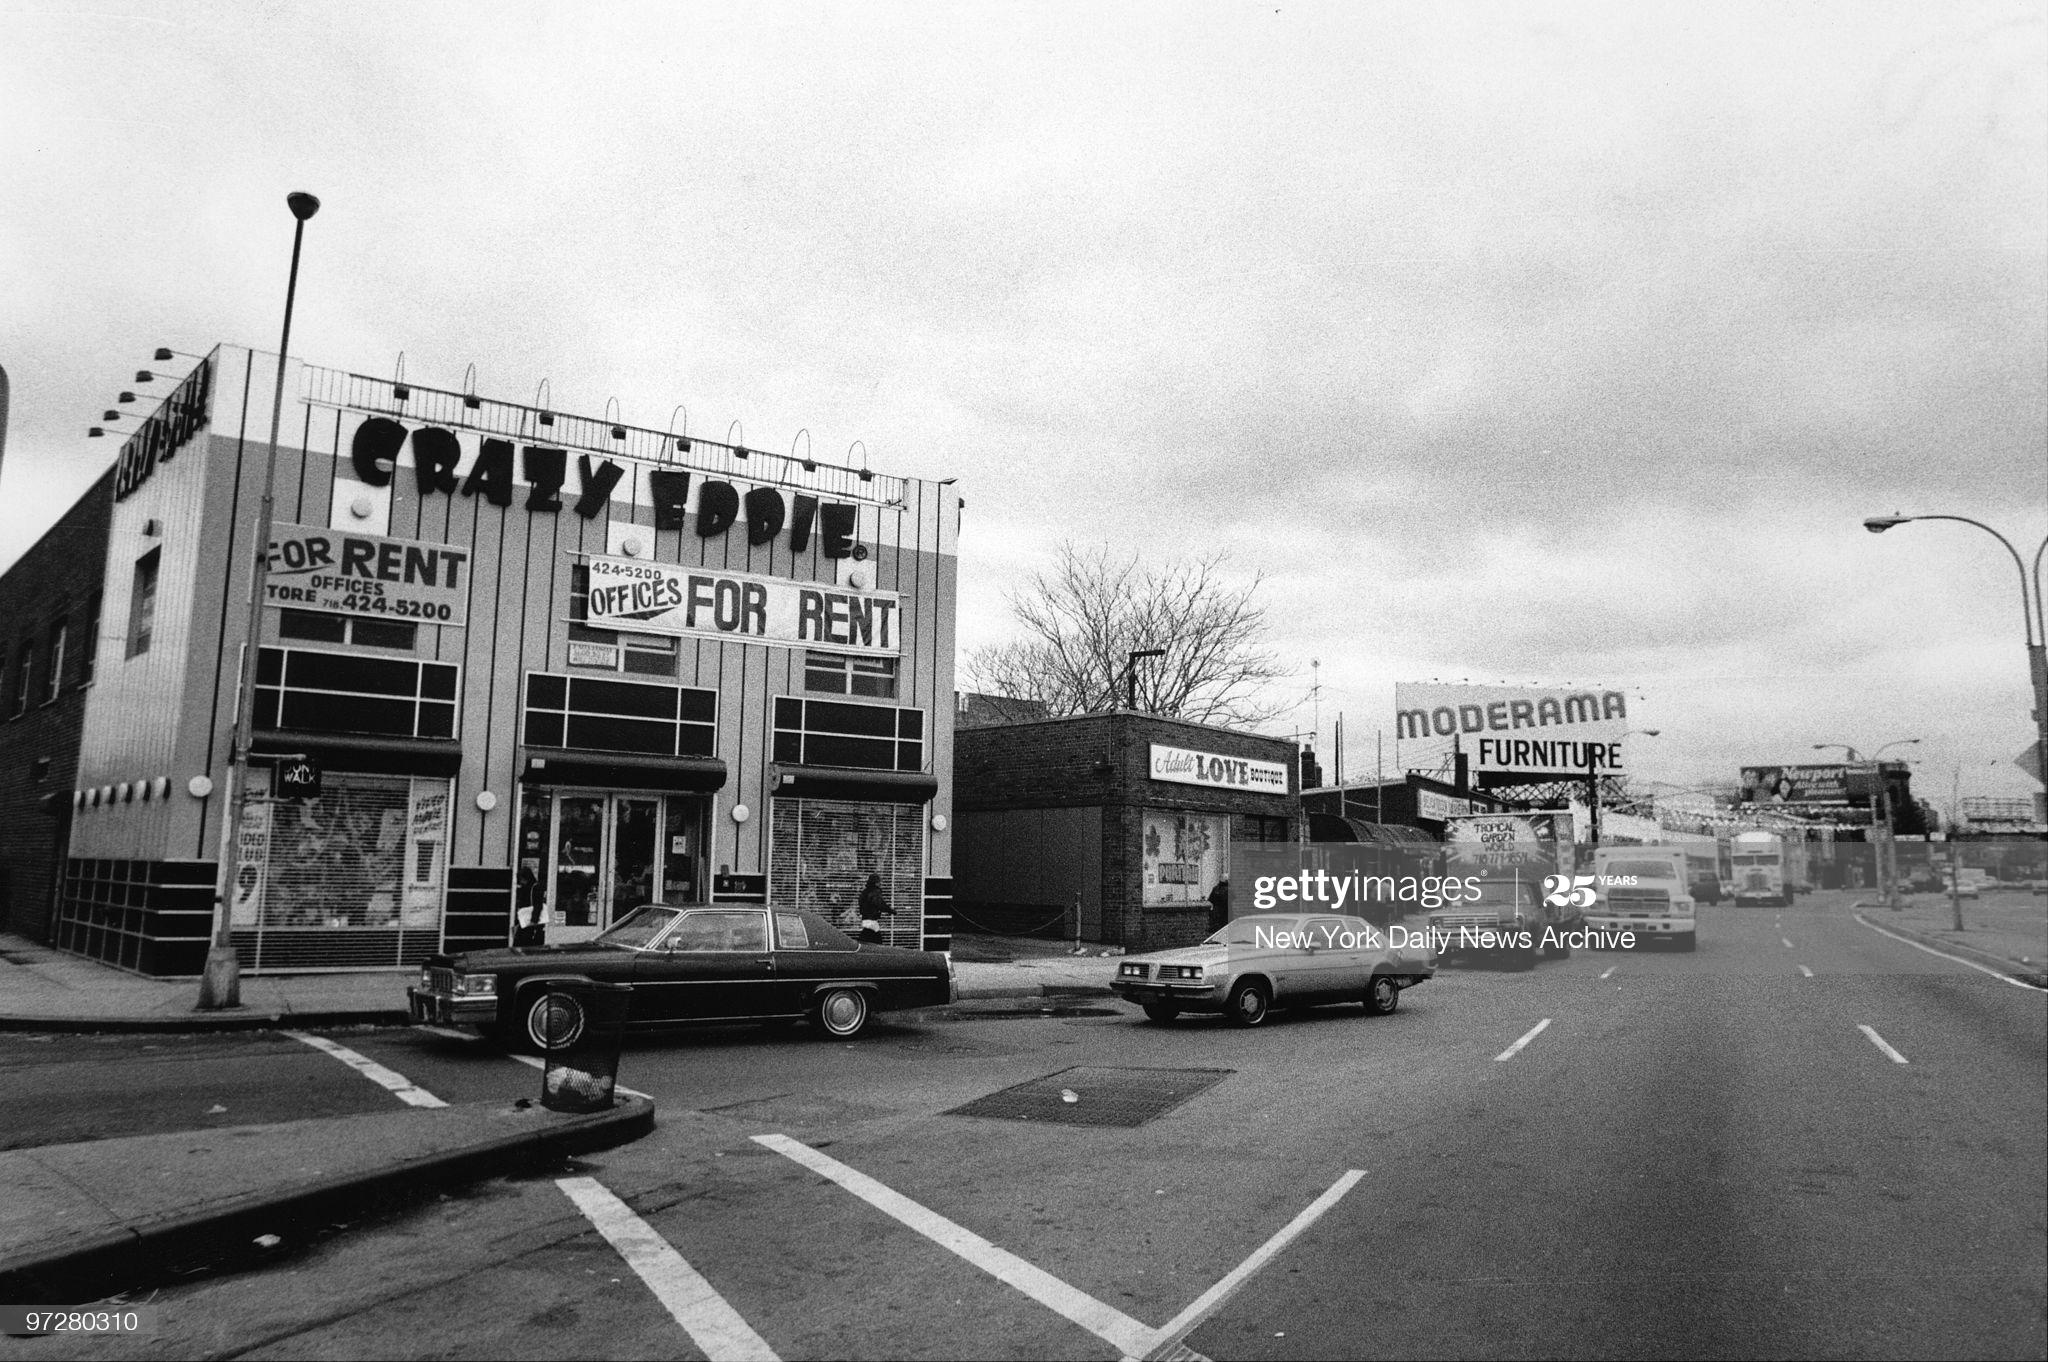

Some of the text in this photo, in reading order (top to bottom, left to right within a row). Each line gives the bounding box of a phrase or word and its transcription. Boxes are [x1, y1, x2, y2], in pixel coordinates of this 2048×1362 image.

[351, 417, 625, 520] CRAZY
[267, 537, 467, 588] FOR RENT
[267, 585, 317, 602] TORE
[311, 575, 384, 596] OFFICES
[590, 577, 682, 616] OFFICES
[685, 574, 896, 648] FOR RENT
[1397, 690, 1627, 739] MODERAMA
[1155, 750, 1283, 785] Adult LOVE BOUTIQUE
[1479, 738, 1624, 769] FURNITURE
[284, 772, 317, 784] WALK
[1781, 766, 1845, 781] Newport
[1474, 821, 1516, 833] TROPICAL
[1481, 832, 1515, 842] GARDEN
